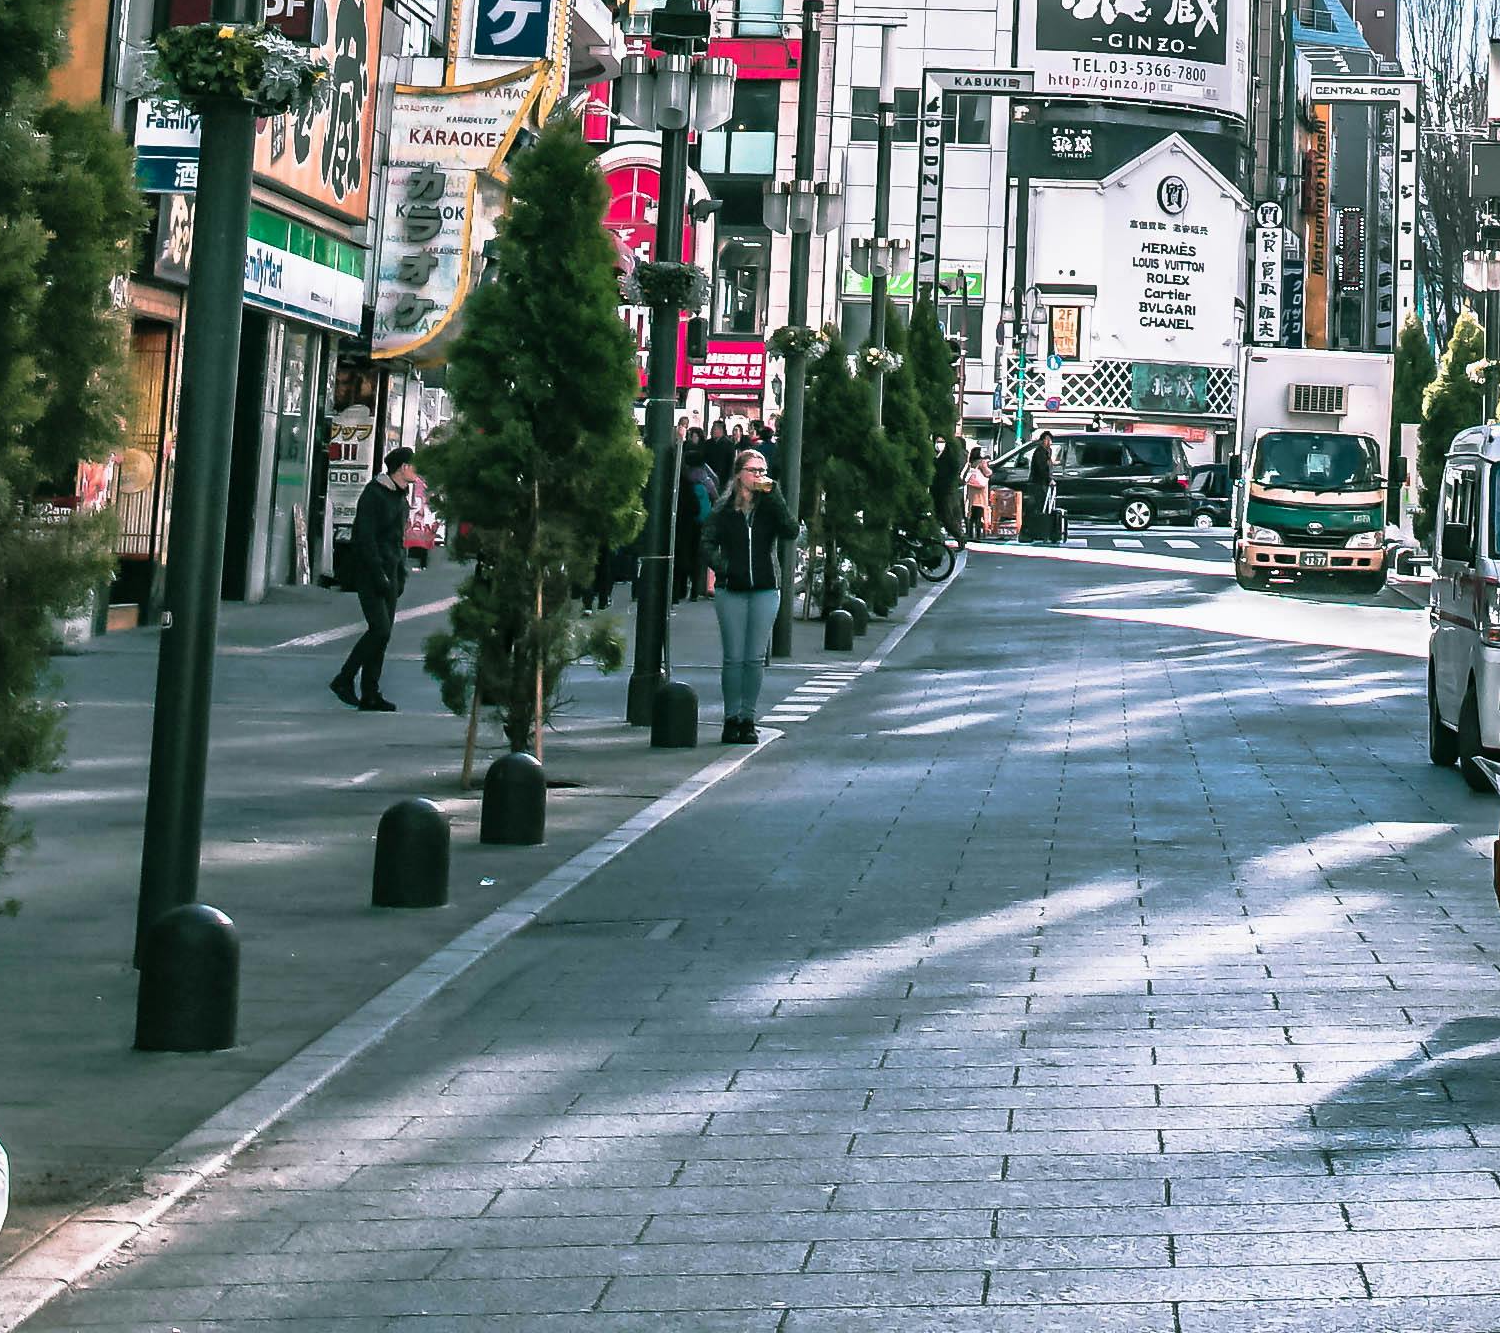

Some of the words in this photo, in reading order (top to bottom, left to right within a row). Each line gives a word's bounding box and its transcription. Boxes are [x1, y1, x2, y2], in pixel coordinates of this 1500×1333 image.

[1072, 58, 1207, 82] TEL.03-5366-7800
[1048, 72, 1156, 94] http://ginzo.jp
[1315, 86, 1369, 95] CENTRAL
[1370, 87, 1401, 96] ROAD
[919, 117, 940, 265] GODZILLA
[1141, 241, 1197, 257] HERMÈS
[1132, 256, 1160, 270] LOUIS
[1164, 258, 1205, 273] VUITTON
[1146, 272, 1190, 286] ROLEX
[1144, 287, 1192, 302] Cartier
[1138, 301, 1196, 316] BVLGARI
[1139, 316, 1195, 331] CHANEL
